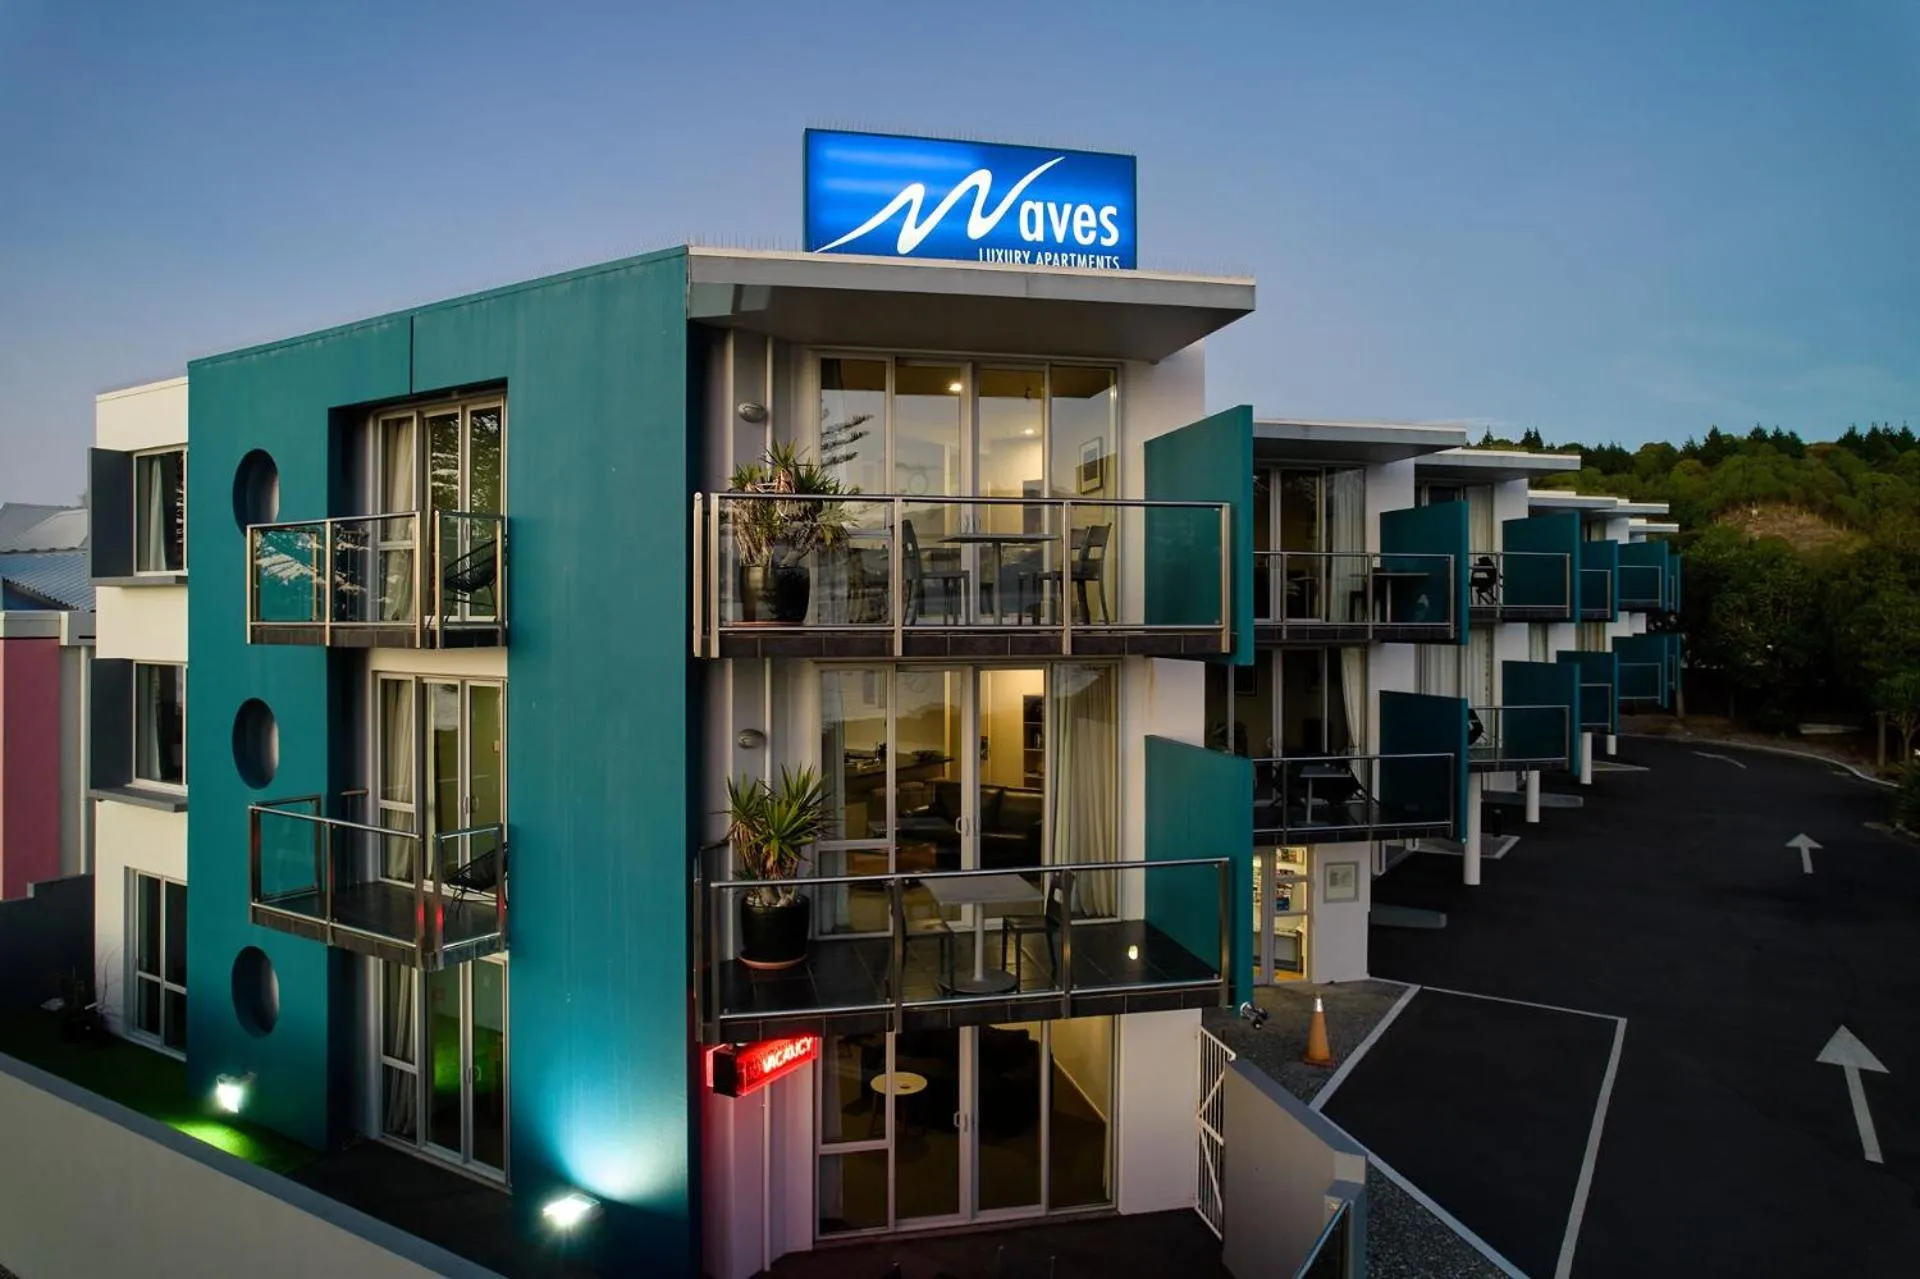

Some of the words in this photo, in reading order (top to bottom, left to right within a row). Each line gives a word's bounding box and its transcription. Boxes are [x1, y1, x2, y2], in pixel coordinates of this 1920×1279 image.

[813, 156, 1119, 254] Waves
[979, 247, 1030, 264] LUXURY
[1036, 251, 1120, 269] APARTMENTS
[762, 1036, 813, 1073] VACANCY
